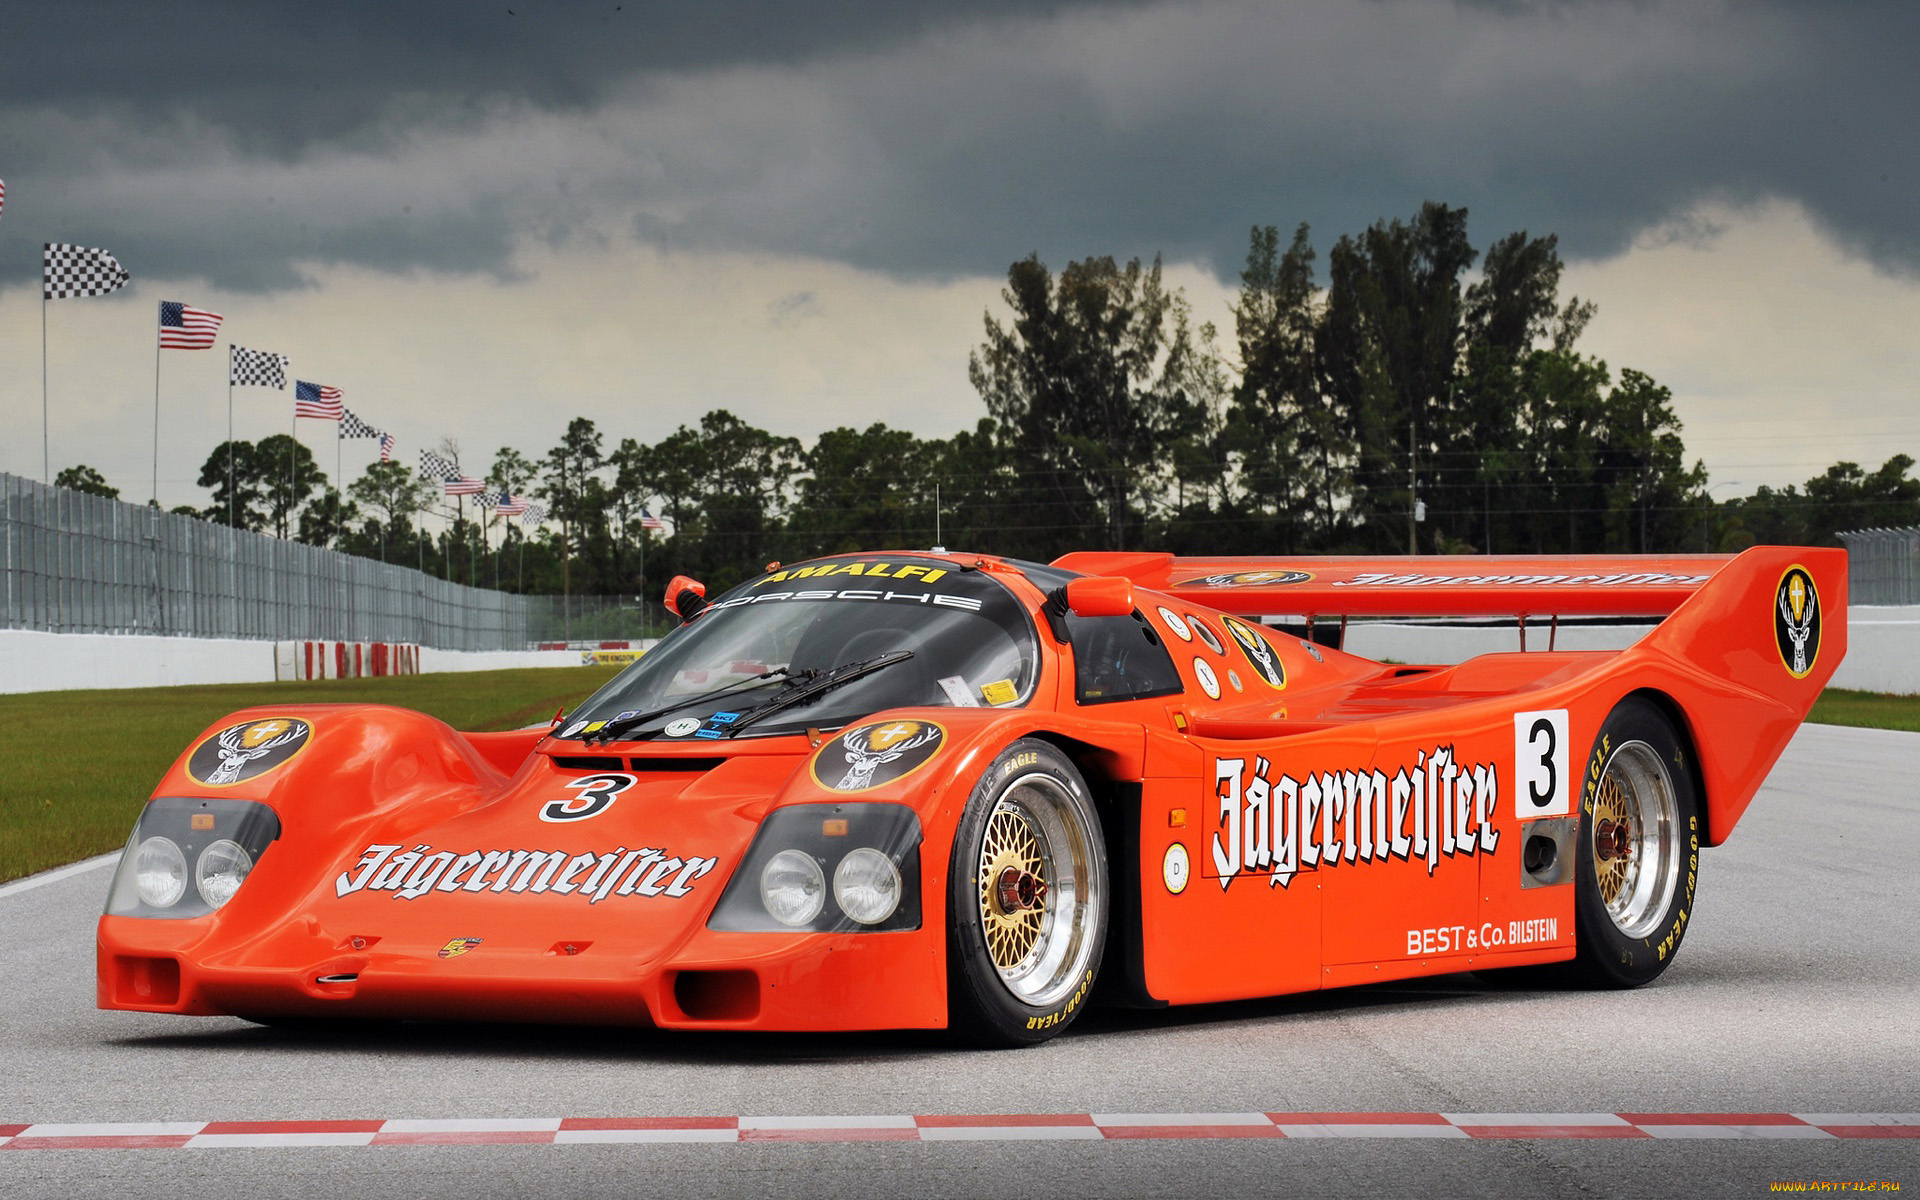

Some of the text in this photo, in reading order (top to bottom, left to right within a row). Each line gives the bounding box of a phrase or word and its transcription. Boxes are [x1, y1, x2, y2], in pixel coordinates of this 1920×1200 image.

[753, 563, 947, 587] AMALFI
[690, 590, 982, 619] PORSCHE
[1004, 752, 1037, 776] EAGLE
[1528, 718, 1556, 808] 3
[1584, 733, 1611, 817] EAGLE
[539, 773, 638, 823] 3
[1212, 743, 1499, 892] Jägermeister
[335, 844, 719, 905] Jägermeister
[1173, 862, 1180, 876] D
[1407, 918, 1557, 955] BEST & Co. BILSTEIN
